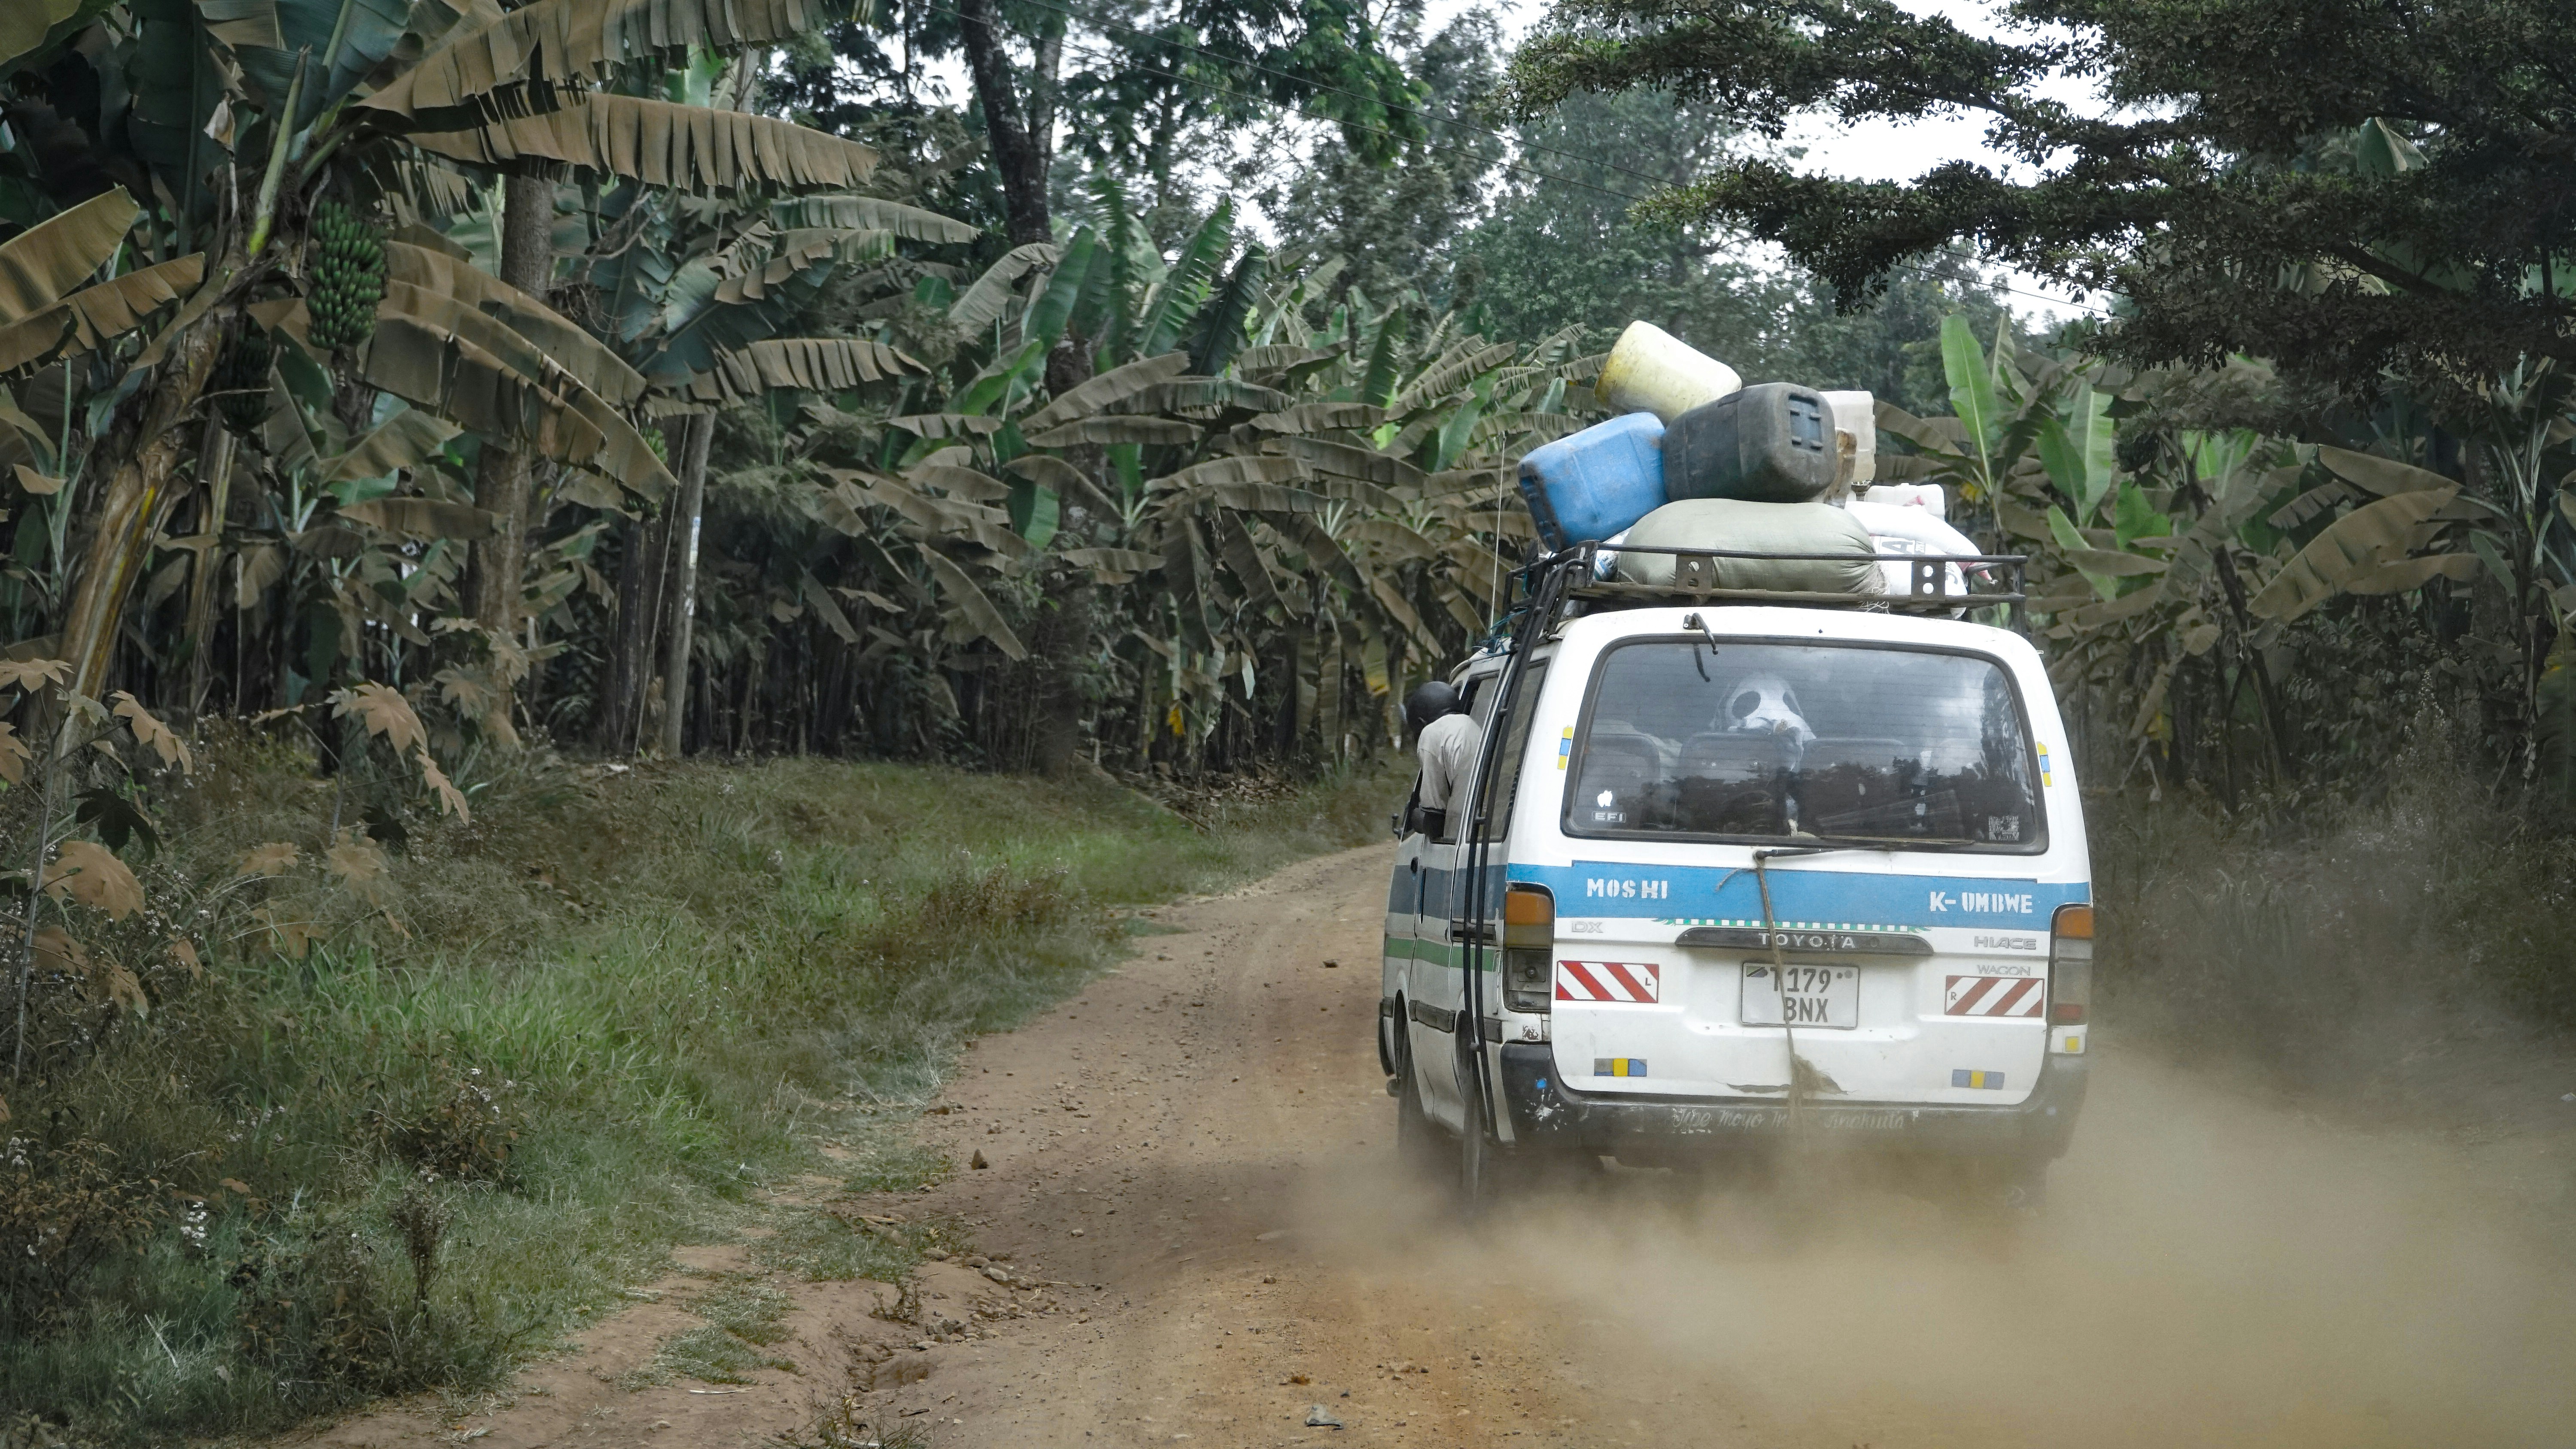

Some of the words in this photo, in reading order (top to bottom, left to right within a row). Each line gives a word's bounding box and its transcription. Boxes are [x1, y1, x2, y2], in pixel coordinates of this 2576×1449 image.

[1595, 812, 1623, 822] EFI
[1586, 878, 1668, 899] MOSHI
[1571, 921, 1604, 933] DX
[1759, 933, 1856, 949] TOYOTA
[1974, 936, 2036, 950] HIACE
[1977, 964, 2031, 976] WAGON
[1645, 977, 1651, 986] L
[1950, 991, 1957, 1000] R
[1783, 997, 1829, 1023] BNX
